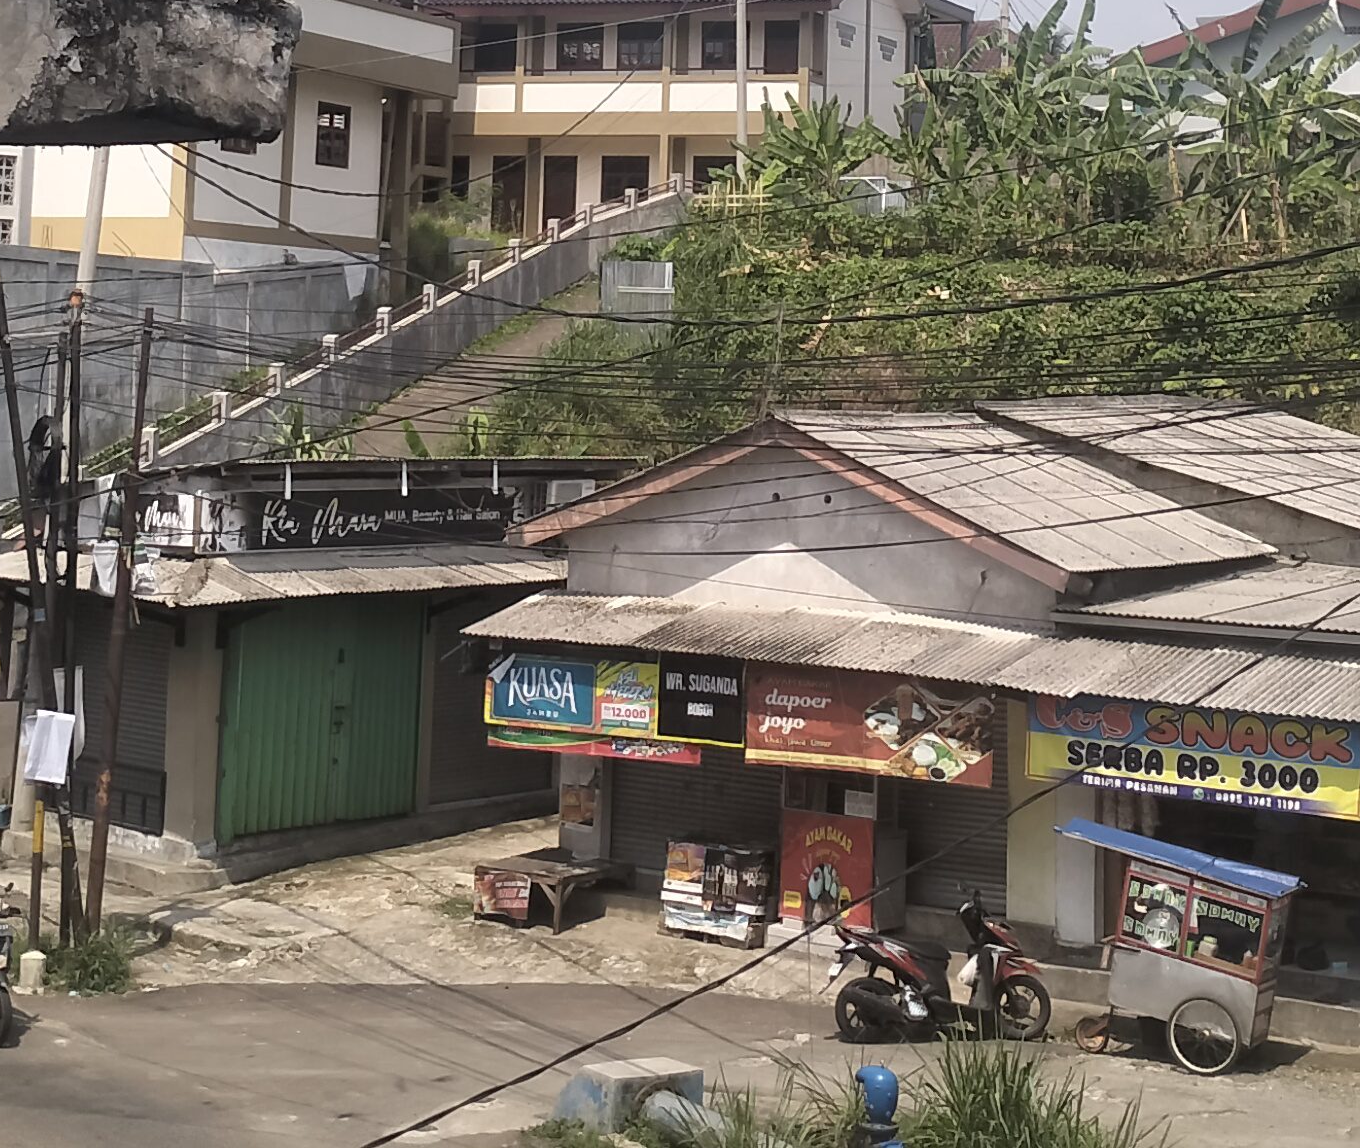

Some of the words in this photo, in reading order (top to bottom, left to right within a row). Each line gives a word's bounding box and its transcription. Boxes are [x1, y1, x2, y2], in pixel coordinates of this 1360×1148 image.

[384, 509, 410, 524] MUA,
[412, 509, 444, 524] Beauty
[446, 508, 454, 521] &
[456, 508, 472, 521] Hair
[475, 508, 501, 520] Salon
[507, 666, 578, 714] KUASA
[666, 672, 686, 691] WR.
[690, 673, 739, 696] SUGANDA
[765, 688, 831, 712] dapoer
[611, 708, 647, 720] 12.000
[759, 712, 805, 734] joyo
[1144, 705, 1353, 764] SNACK
[1067, 740, 1164, 776] SERBA
[1177, 754, 1226, 784] RP.
[1240, 760, 1319, 794] 3000
[1126, 780, 1178, 796] PESANAN
[805, 826, 826, 848] AYAM
[827, 825, 853, 855] BAKAR
